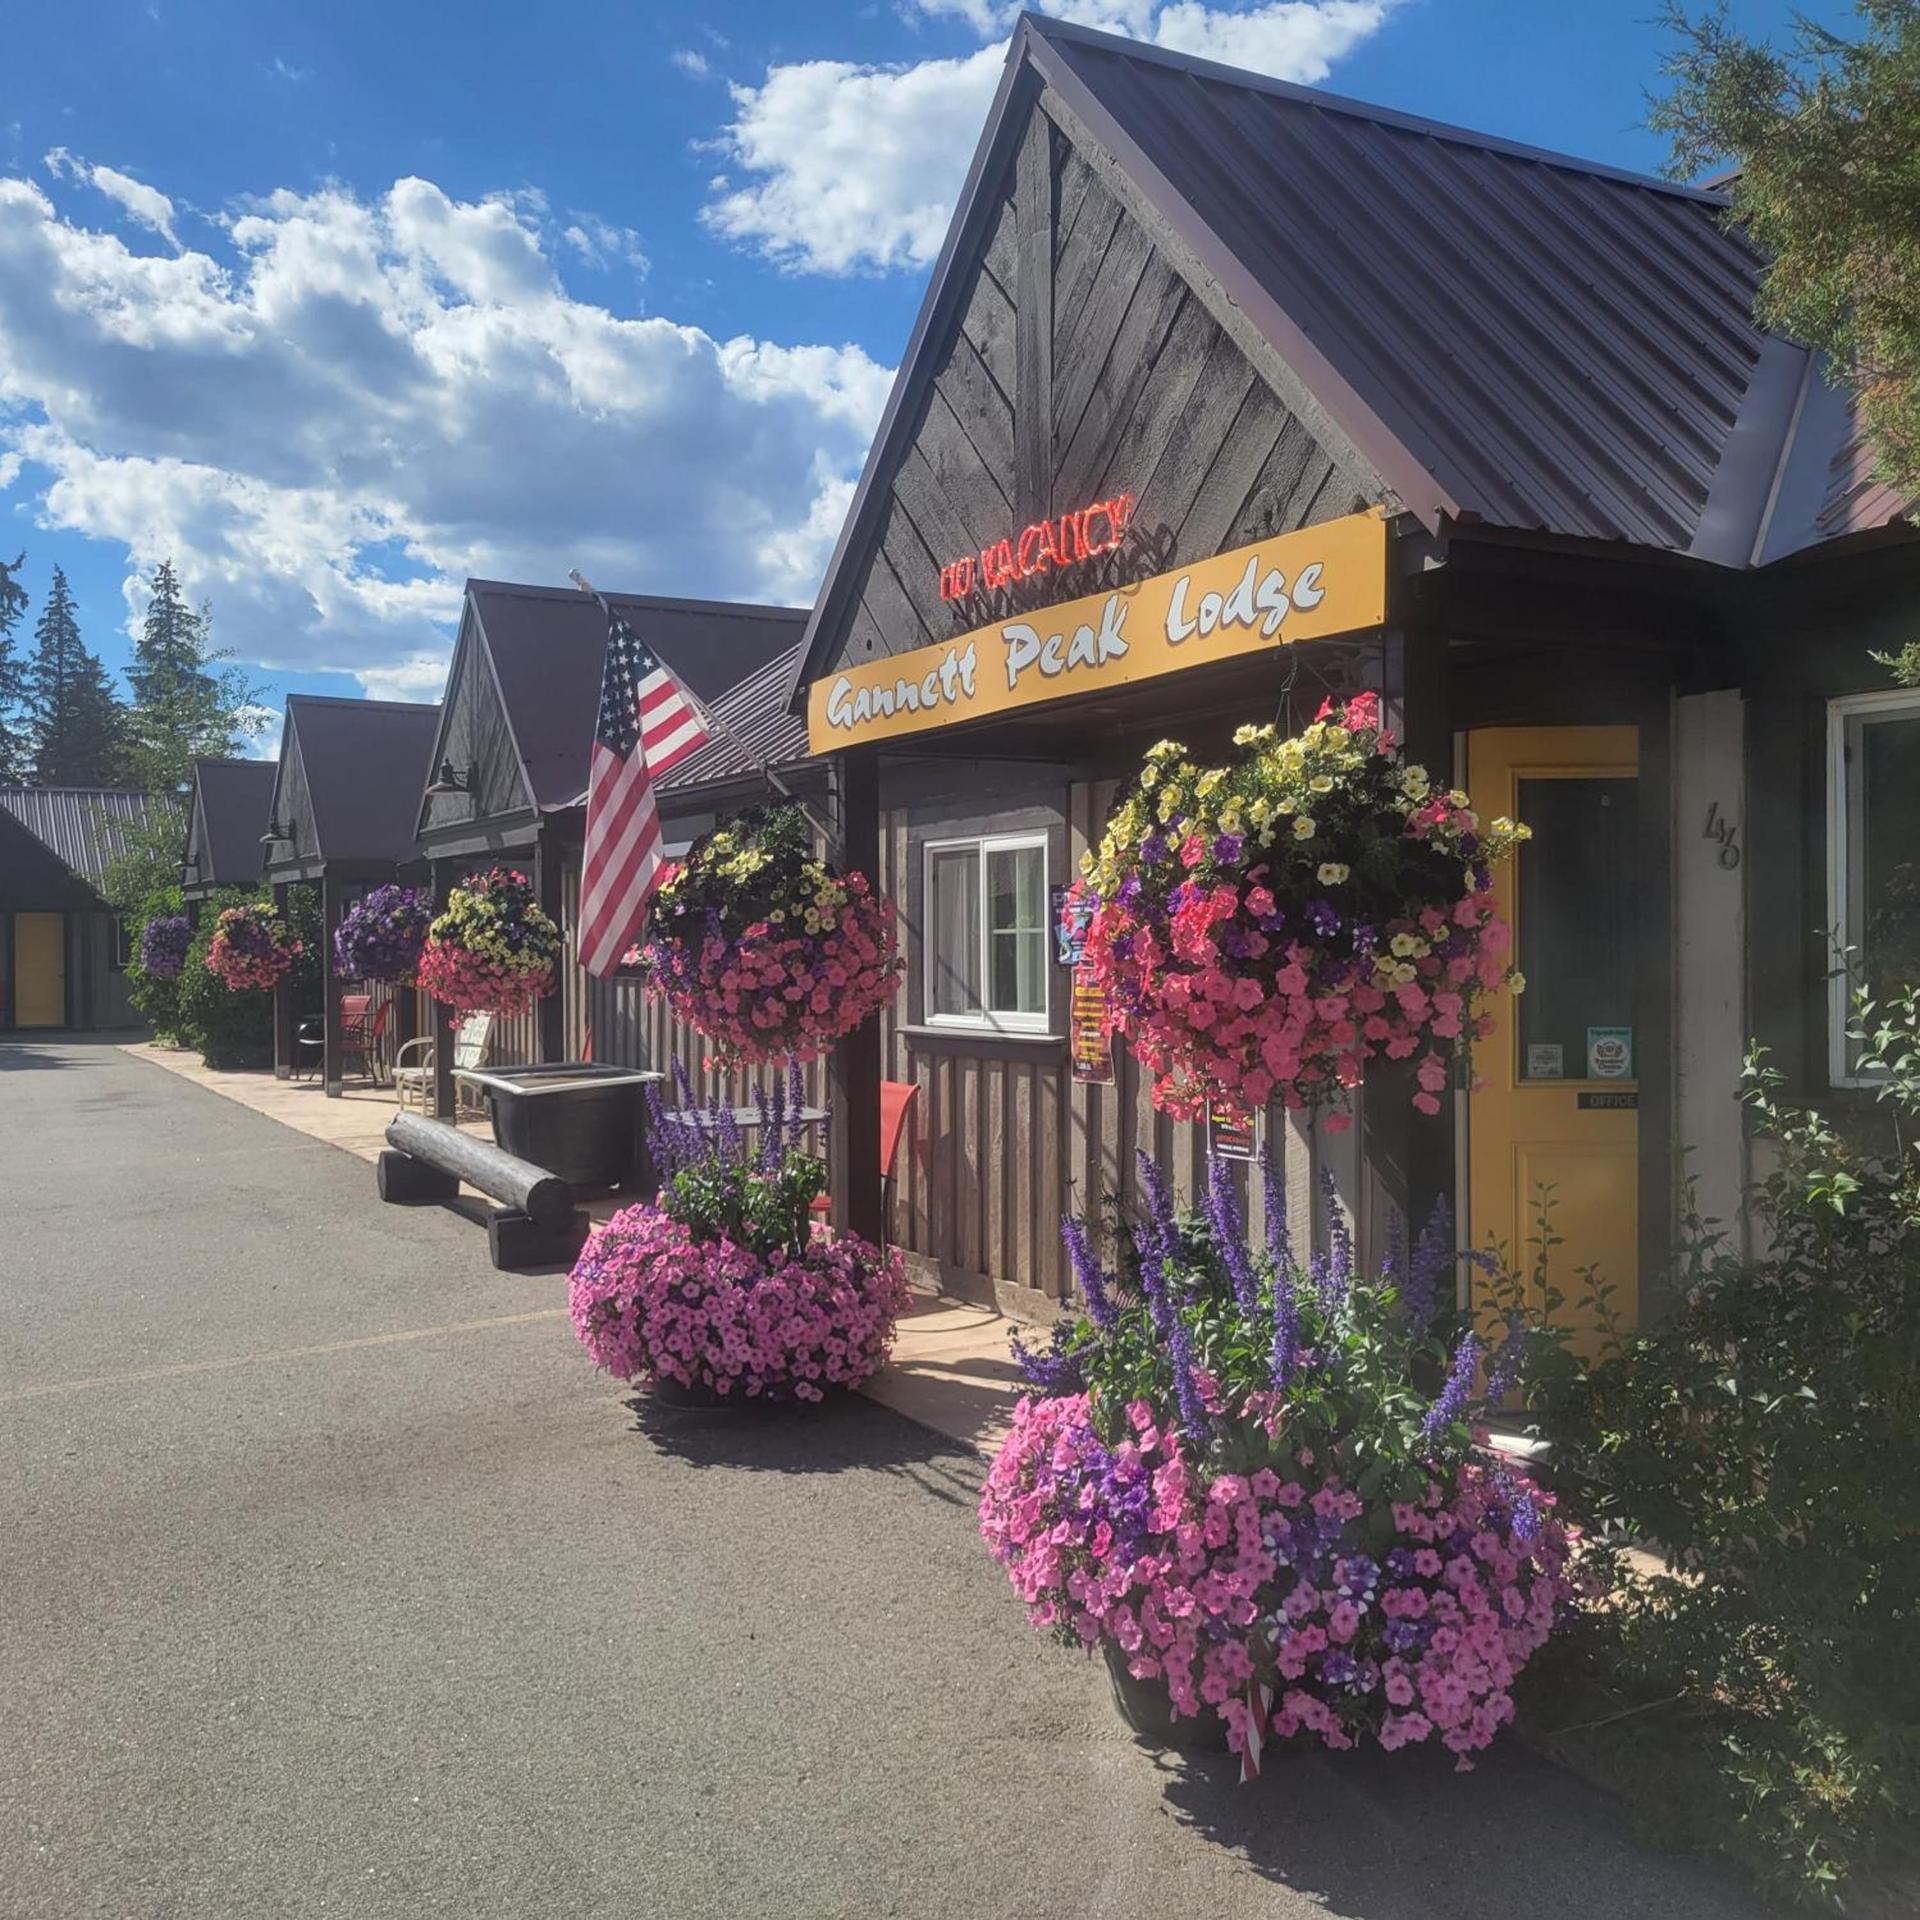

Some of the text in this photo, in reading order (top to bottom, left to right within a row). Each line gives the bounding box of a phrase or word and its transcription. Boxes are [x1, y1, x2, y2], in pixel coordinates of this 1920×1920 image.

[981, 491, 1134, 589] VACANCY
[826, 554, 1325, 729] Gannett Peak Lodge
[1702, 802, 1740, 871] 46
[1590, 1095, 1636, 1107] OFFICE
